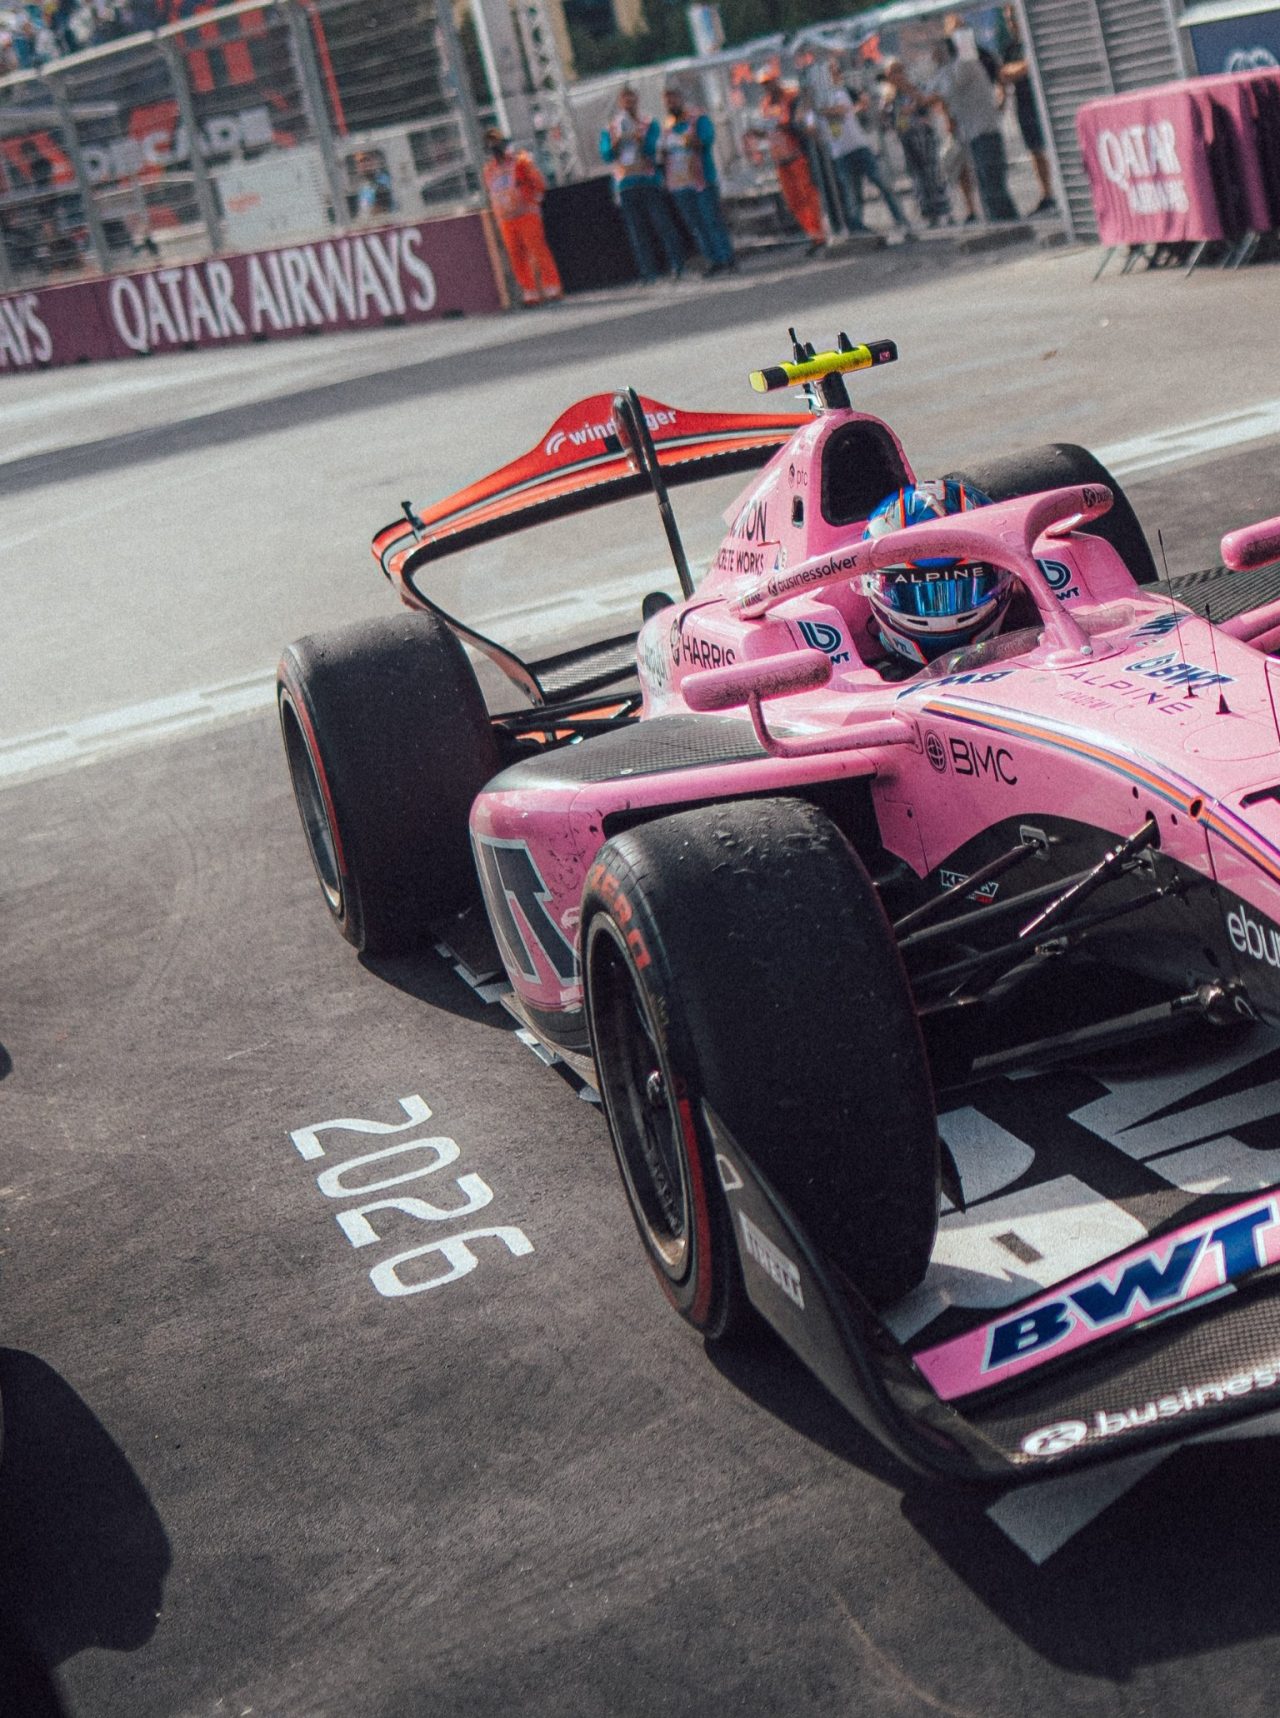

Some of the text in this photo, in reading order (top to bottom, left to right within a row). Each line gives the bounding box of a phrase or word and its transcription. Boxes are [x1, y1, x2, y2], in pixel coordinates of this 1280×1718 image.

[1098, 120, 1182, 192] QATAR
[110, 228, 436, 353] QATAR AIRWAYS
[777, 555, 858, 593] businessolver
[894, 566, 984, 584] ALPINE
[681, 633, 736, 669] HARRIS
[1060, 670, 1194, 715] ALPINE
[949, 737, 1018, 785] BMC
[289, 1094, 535, 1297] 2026
[980, 1199, 1279, 1374] BWT
